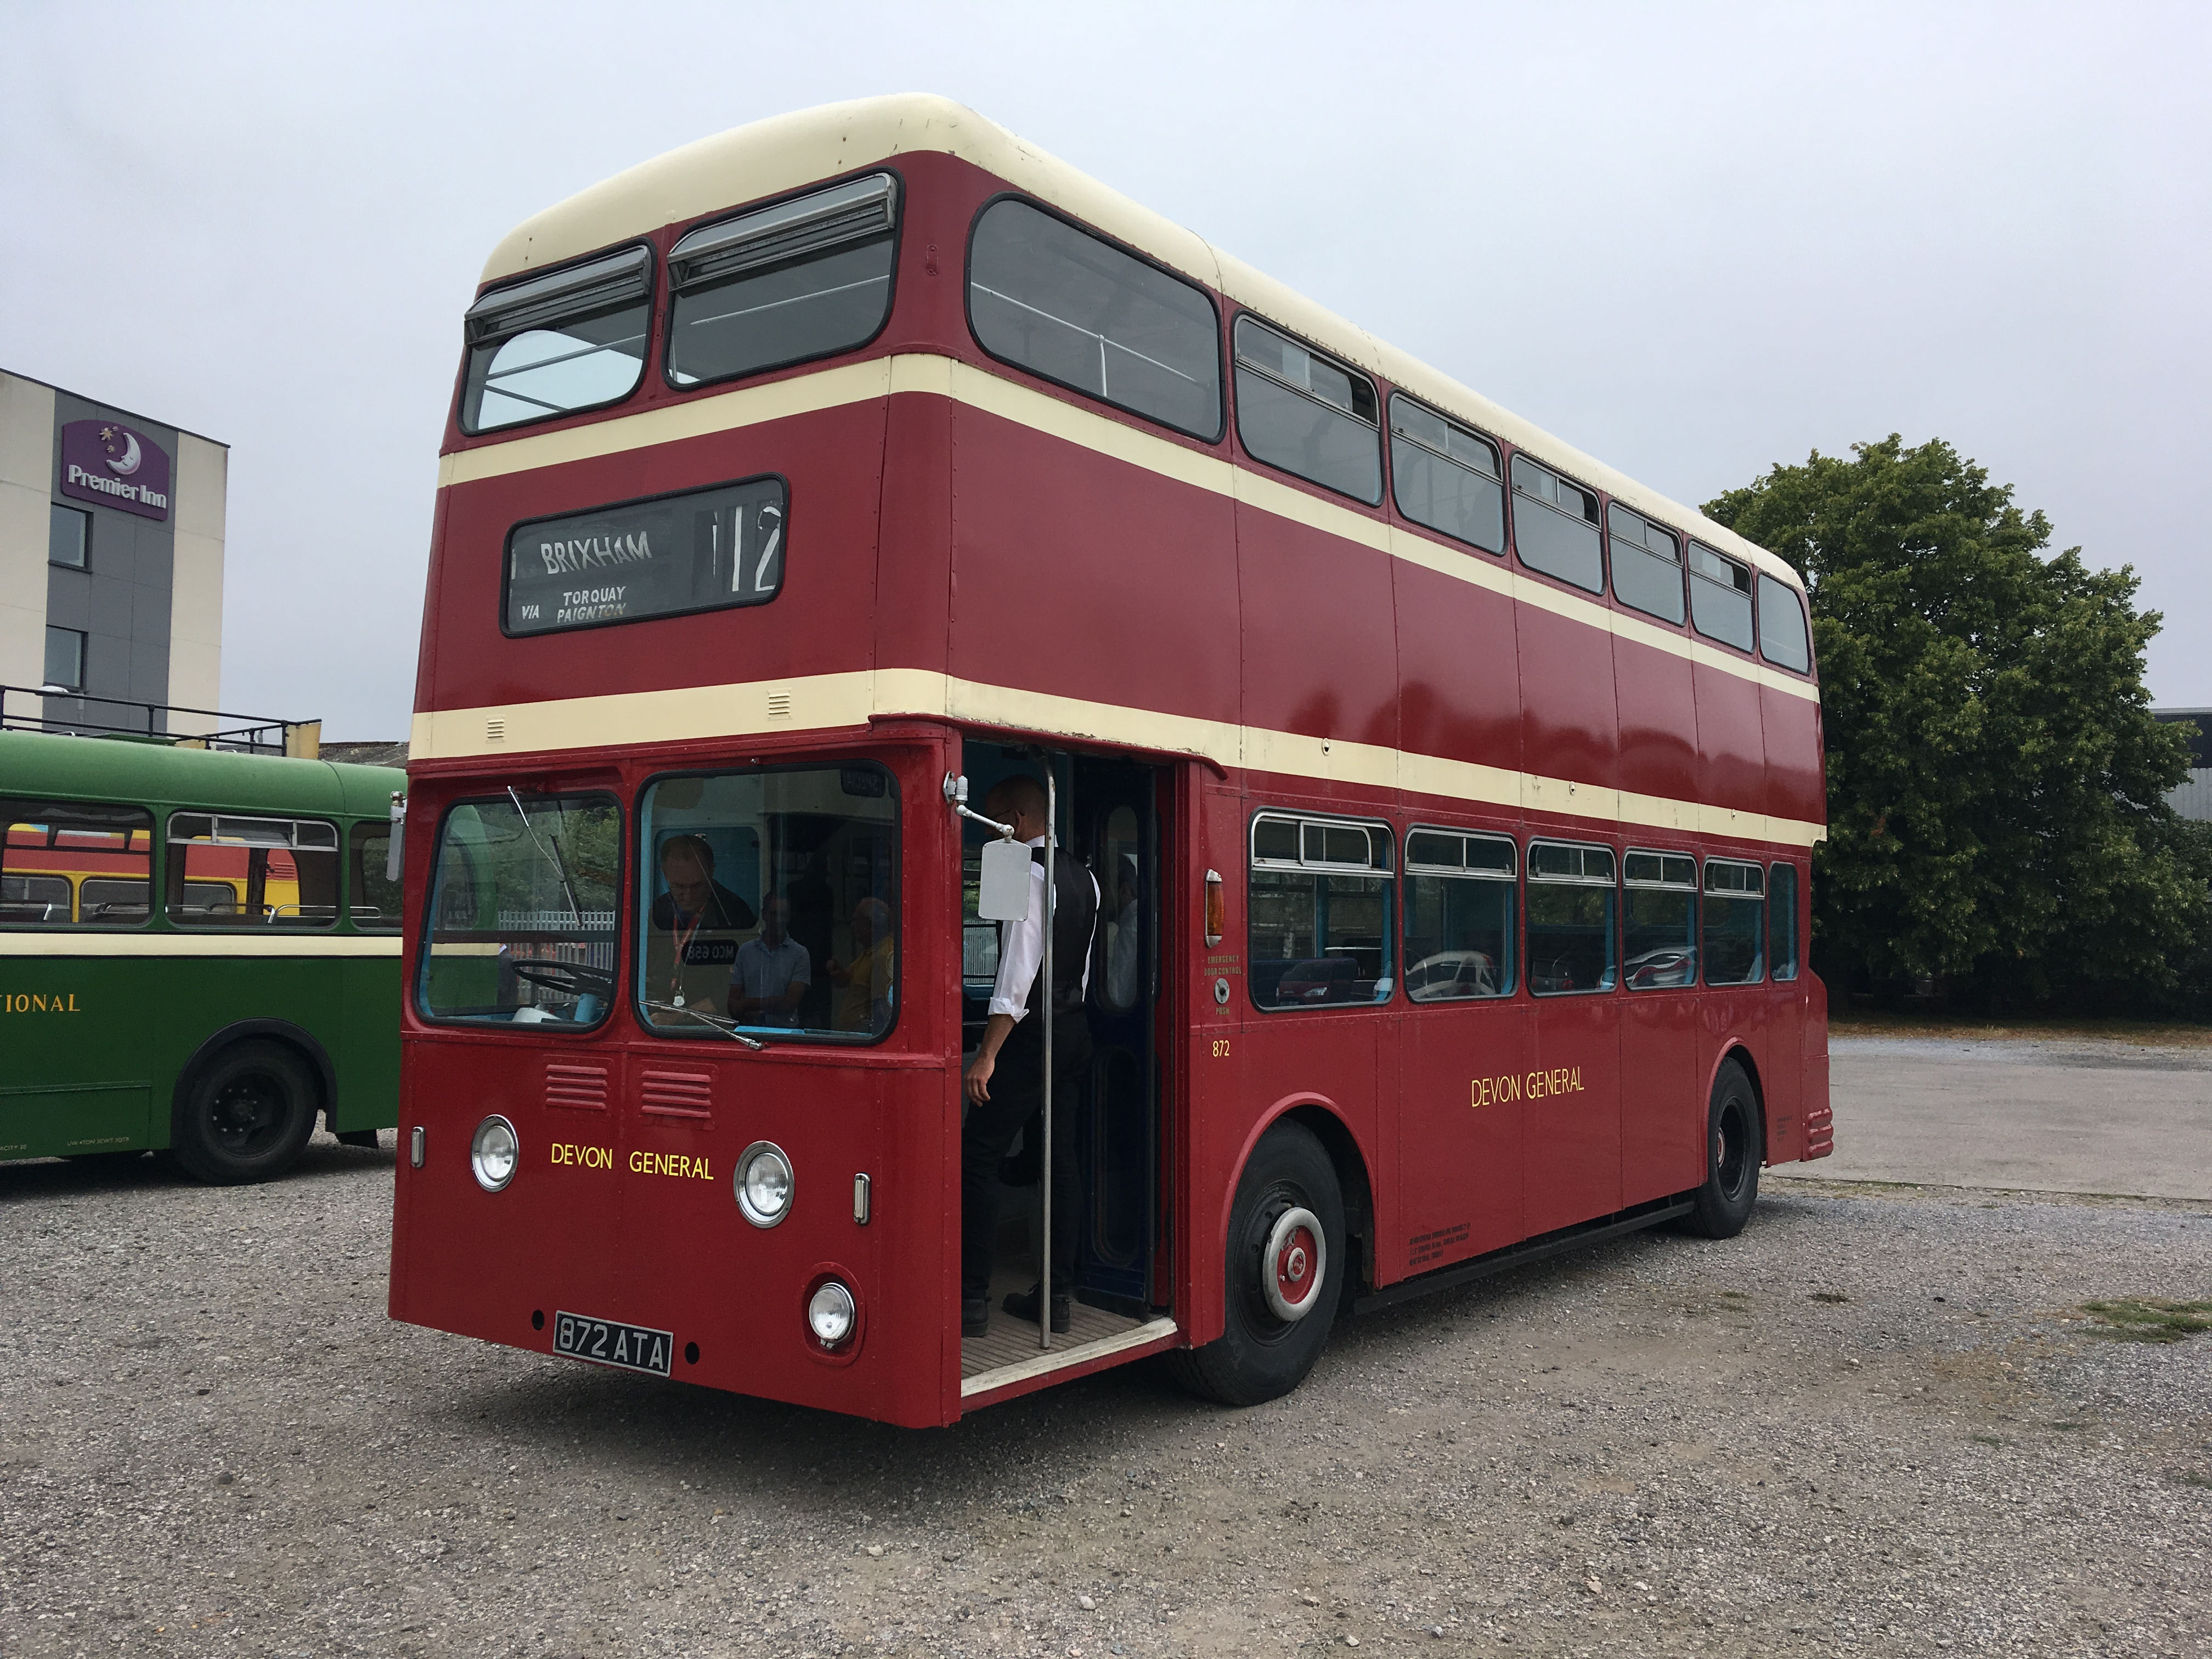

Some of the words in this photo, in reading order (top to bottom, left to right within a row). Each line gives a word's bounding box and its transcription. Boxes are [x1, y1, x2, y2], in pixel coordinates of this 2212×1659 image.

[68, 464, 139, 500] Premier
[139, 484, 167, 509] Inn
[540, 531, 652, 574] BRIXHAM
[563, 586, 627, 606] TORQUAY
[522, 605, 540, 619] VIA
[557, 602, 627, 623] PAIGNTON
[1207, 955, 1239, 964] EMERGENCY
[1204, 968, 1217, 976] DOOR
[1218, 966, 1242, 975] CONTROL
[0, 994, 81, 1013] IONAL
[1216, 1007, 1229, 1015] PUSH
[1212, 1040, 1229, 1057] 872
[1471, 1074, 1520, 1108] DEVON
[1526, 1066, 1584, 1099] GENERAL
[551, 1143, 613, 1170] DEVON
[629, 1151, 714, 1180] GENERAL
[559, 1318, 608, 1357] 872
[613, 1329, 663, 1369] ATA
